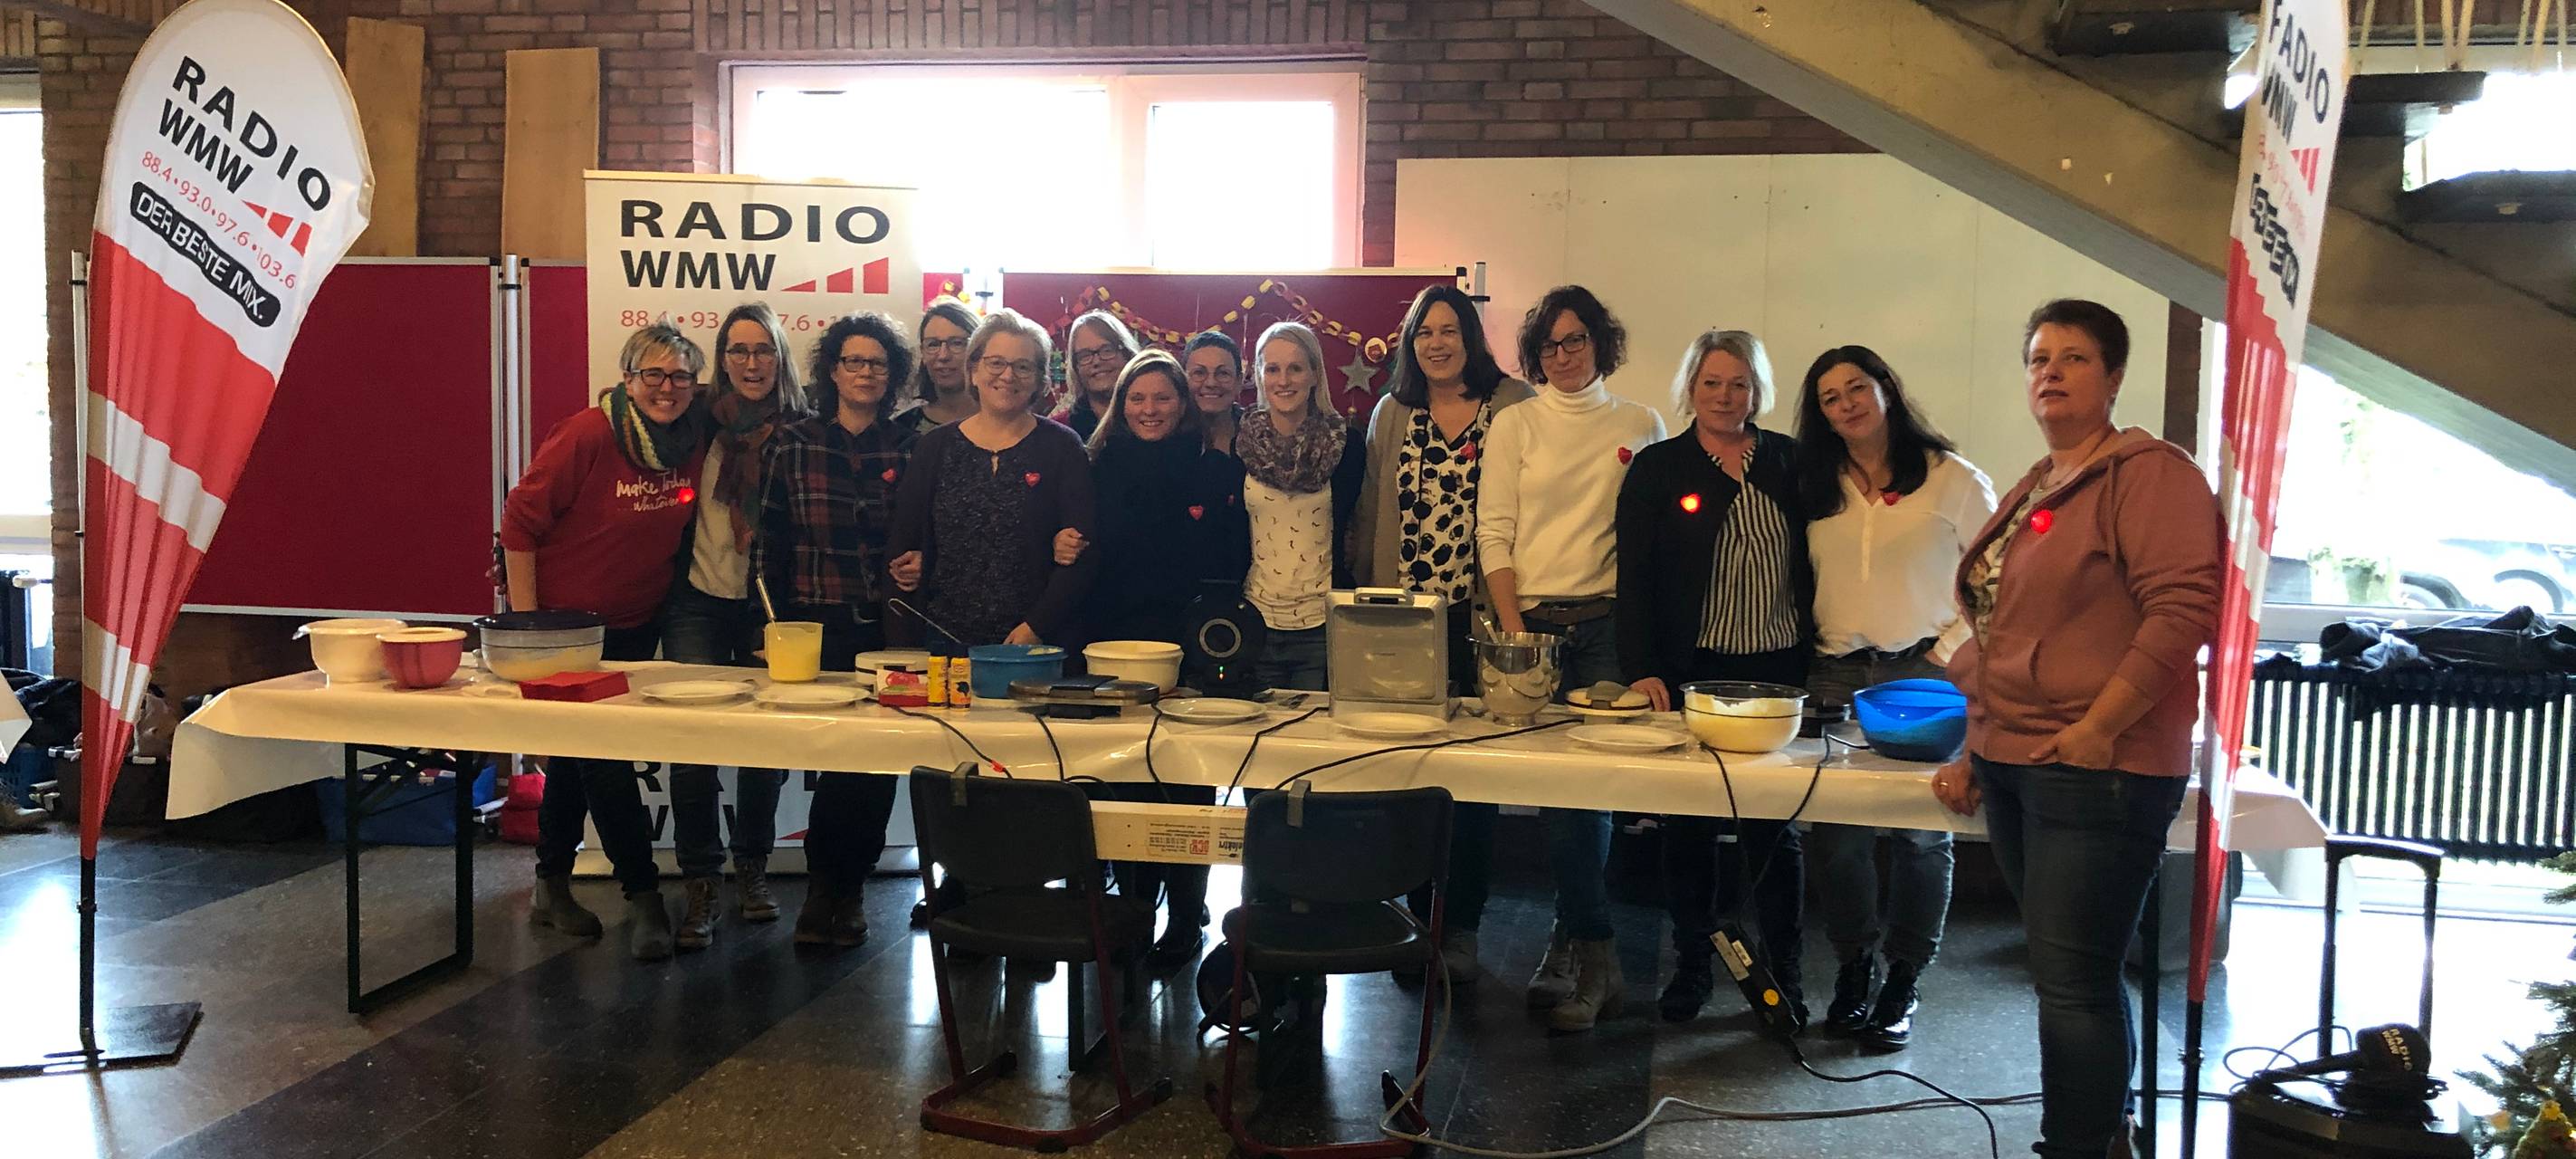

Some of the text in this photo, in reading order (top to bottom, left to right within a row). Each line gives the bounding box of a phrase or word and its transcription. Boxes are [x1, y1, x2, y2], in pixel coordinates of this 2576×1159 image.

[158, 98, 253, 194] WMW
[172, 55, 331, 212] RADIO
[621, 199, 890, 244] RADIO
[136, 191, 264, 320] DER BESTE MIX.
[620, 250, 777, 291] WMW
[692, 311, 719, 329] 93
[2382, 1030, 2400, 1055] WMW
[2390, 1028, 2413, 1071] RADIO
